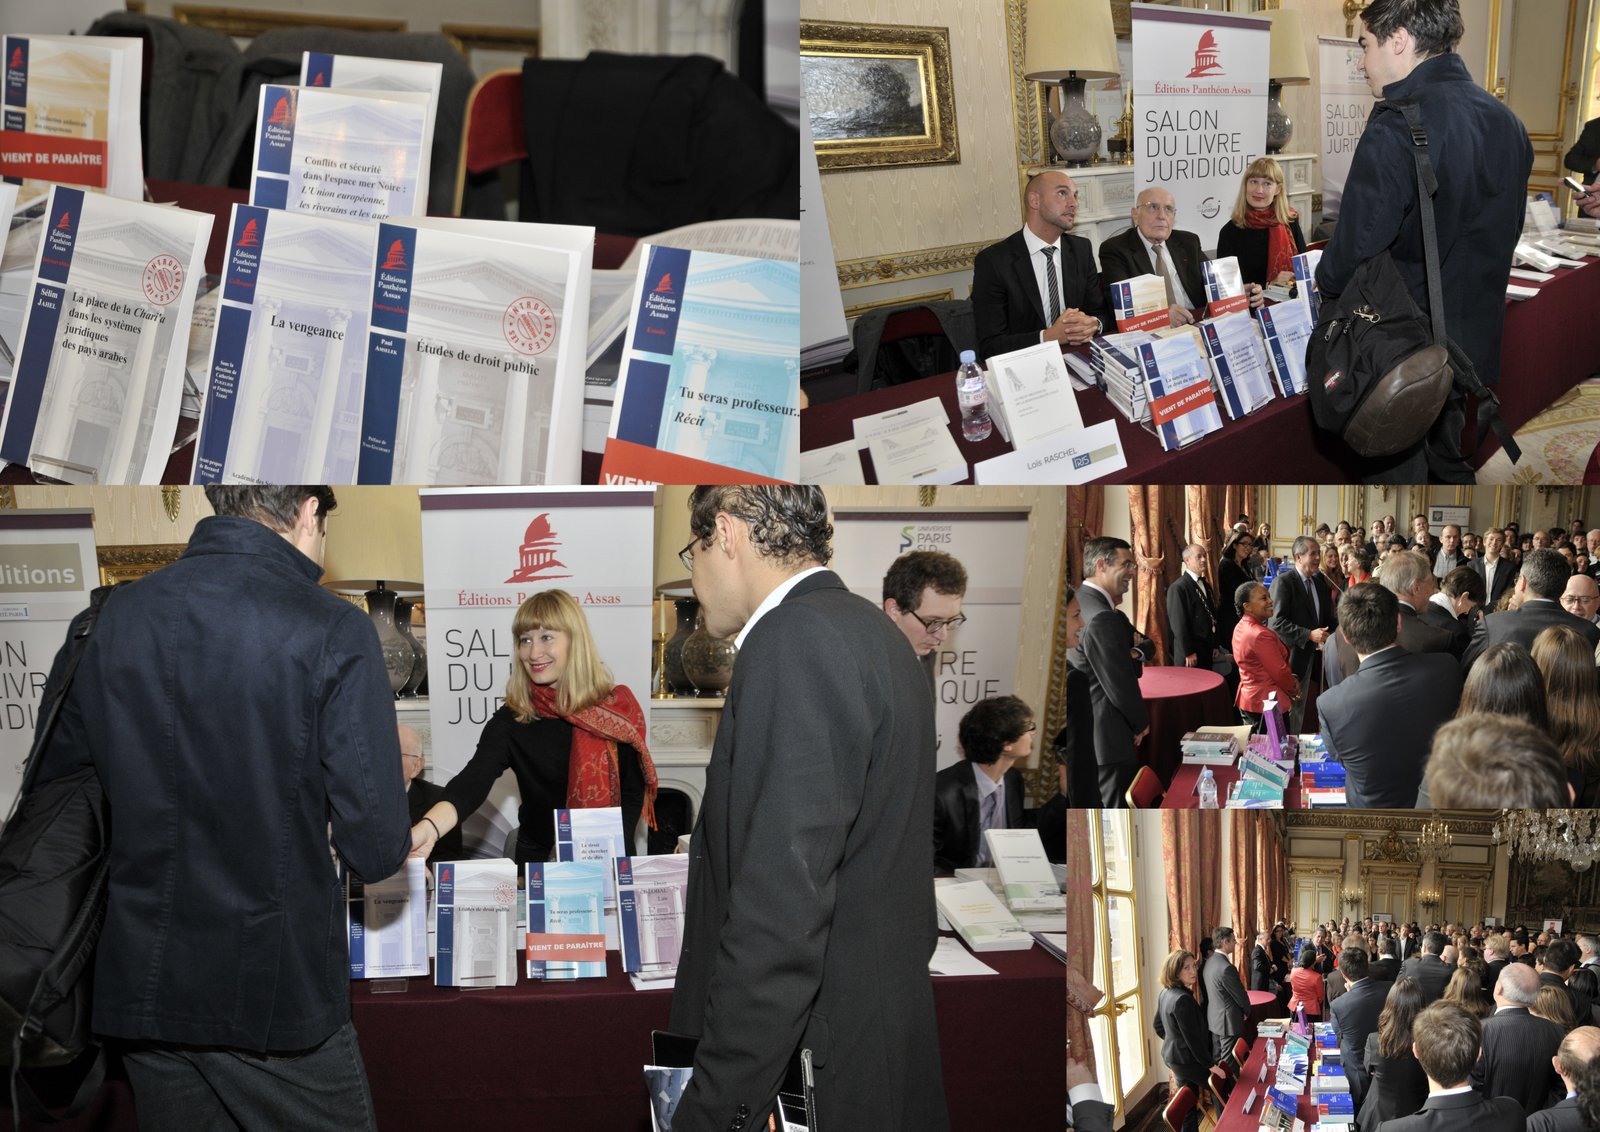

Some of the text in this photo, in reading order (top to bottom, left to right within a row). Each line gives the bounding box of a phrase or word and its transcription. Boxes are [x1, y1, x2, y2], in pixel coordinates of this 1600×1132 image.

[1155, 81, 1251, 95] Éditions Panthéon Assas
[1326, 103, 1366, 120] SALON
[1145, 109, 1218, 133] SALON
[1327, 121, 1344, 137] DU
[265, 132, 291, 142] Panthéon
[267, 125, 291, 134] Éditions
[1146, 132, 1241, 158] DU LIVRE
[1, 152, 102, 164] VIENT DE PARAÎTRE
[304, 156, 381, 174] Conflits et sécurité
[303, 171, 322, 181] dans
[325, 173, 356, 186] l'espace
[358, 179, 376, 188] mer
[378, 181, 400, 193] Noire
[301, 186, 385, 206] L'Union européenne,
[299, 200, 311, 210] les
[312, 203, 347, 215] riverains
[349, 208, 358, 216] et
[359, 209, 370, 218] les
[50, 237, 72, 247] Panthéon
[52, 229, 71, 239] Éditions
[52, 244, 66, 252] Assas
[235, 249, 257, 260] Éditions
[232, 257, 258, 268] Panthéon
[236, 265, 251, 274] Assas
[380, 272, 406, 284] Éditions
[40, 288, 58, 299] Sélim
[378, 281, 408, 293] Panthéon
[382, 291, 401, 299] Assas
[37, 300, 57, 310] JAHEL
[645, 300, 677, 313] Panthéon
[649, 292, 676, 305] Éditions
[73, 292, 166, 324] La place de la Chari'a
[650, 310, 669, 319] Assas
[68, 309, 142, 335] dans les systèmes
[271, 315, 344, 341] La vengeance
[1125, 322, 1140, 332] VIENT
[1147, 313, 1169, 325] PARAÎTRE
[64, 324, 109, 343] juridiques
[381, 338, 393, 347] Paul
[62, 339, 128, 364] des pays arabes
[416, 340, 540, 377] Études de droit public
[680, 386, 694, 400] Tu
[698, 391, 728, 406] seras
[1159, 386, 1211, 416] VIENT DE PARAÎTRE
[674, 411, 705, 427] Récit
[1044, 448, 1077, 464] RASCHEL
[917, 533, 952, 543] PARIS
[0, 565, 76, 585] itions
[458, 590, 511, 607] Éditions
[583, 592, 621, 605] Assas
[445, 629, 510, 658] SAL
[448, 663, 494, 692] DU
[566, 941, 604, 949] PARAÎTRE
